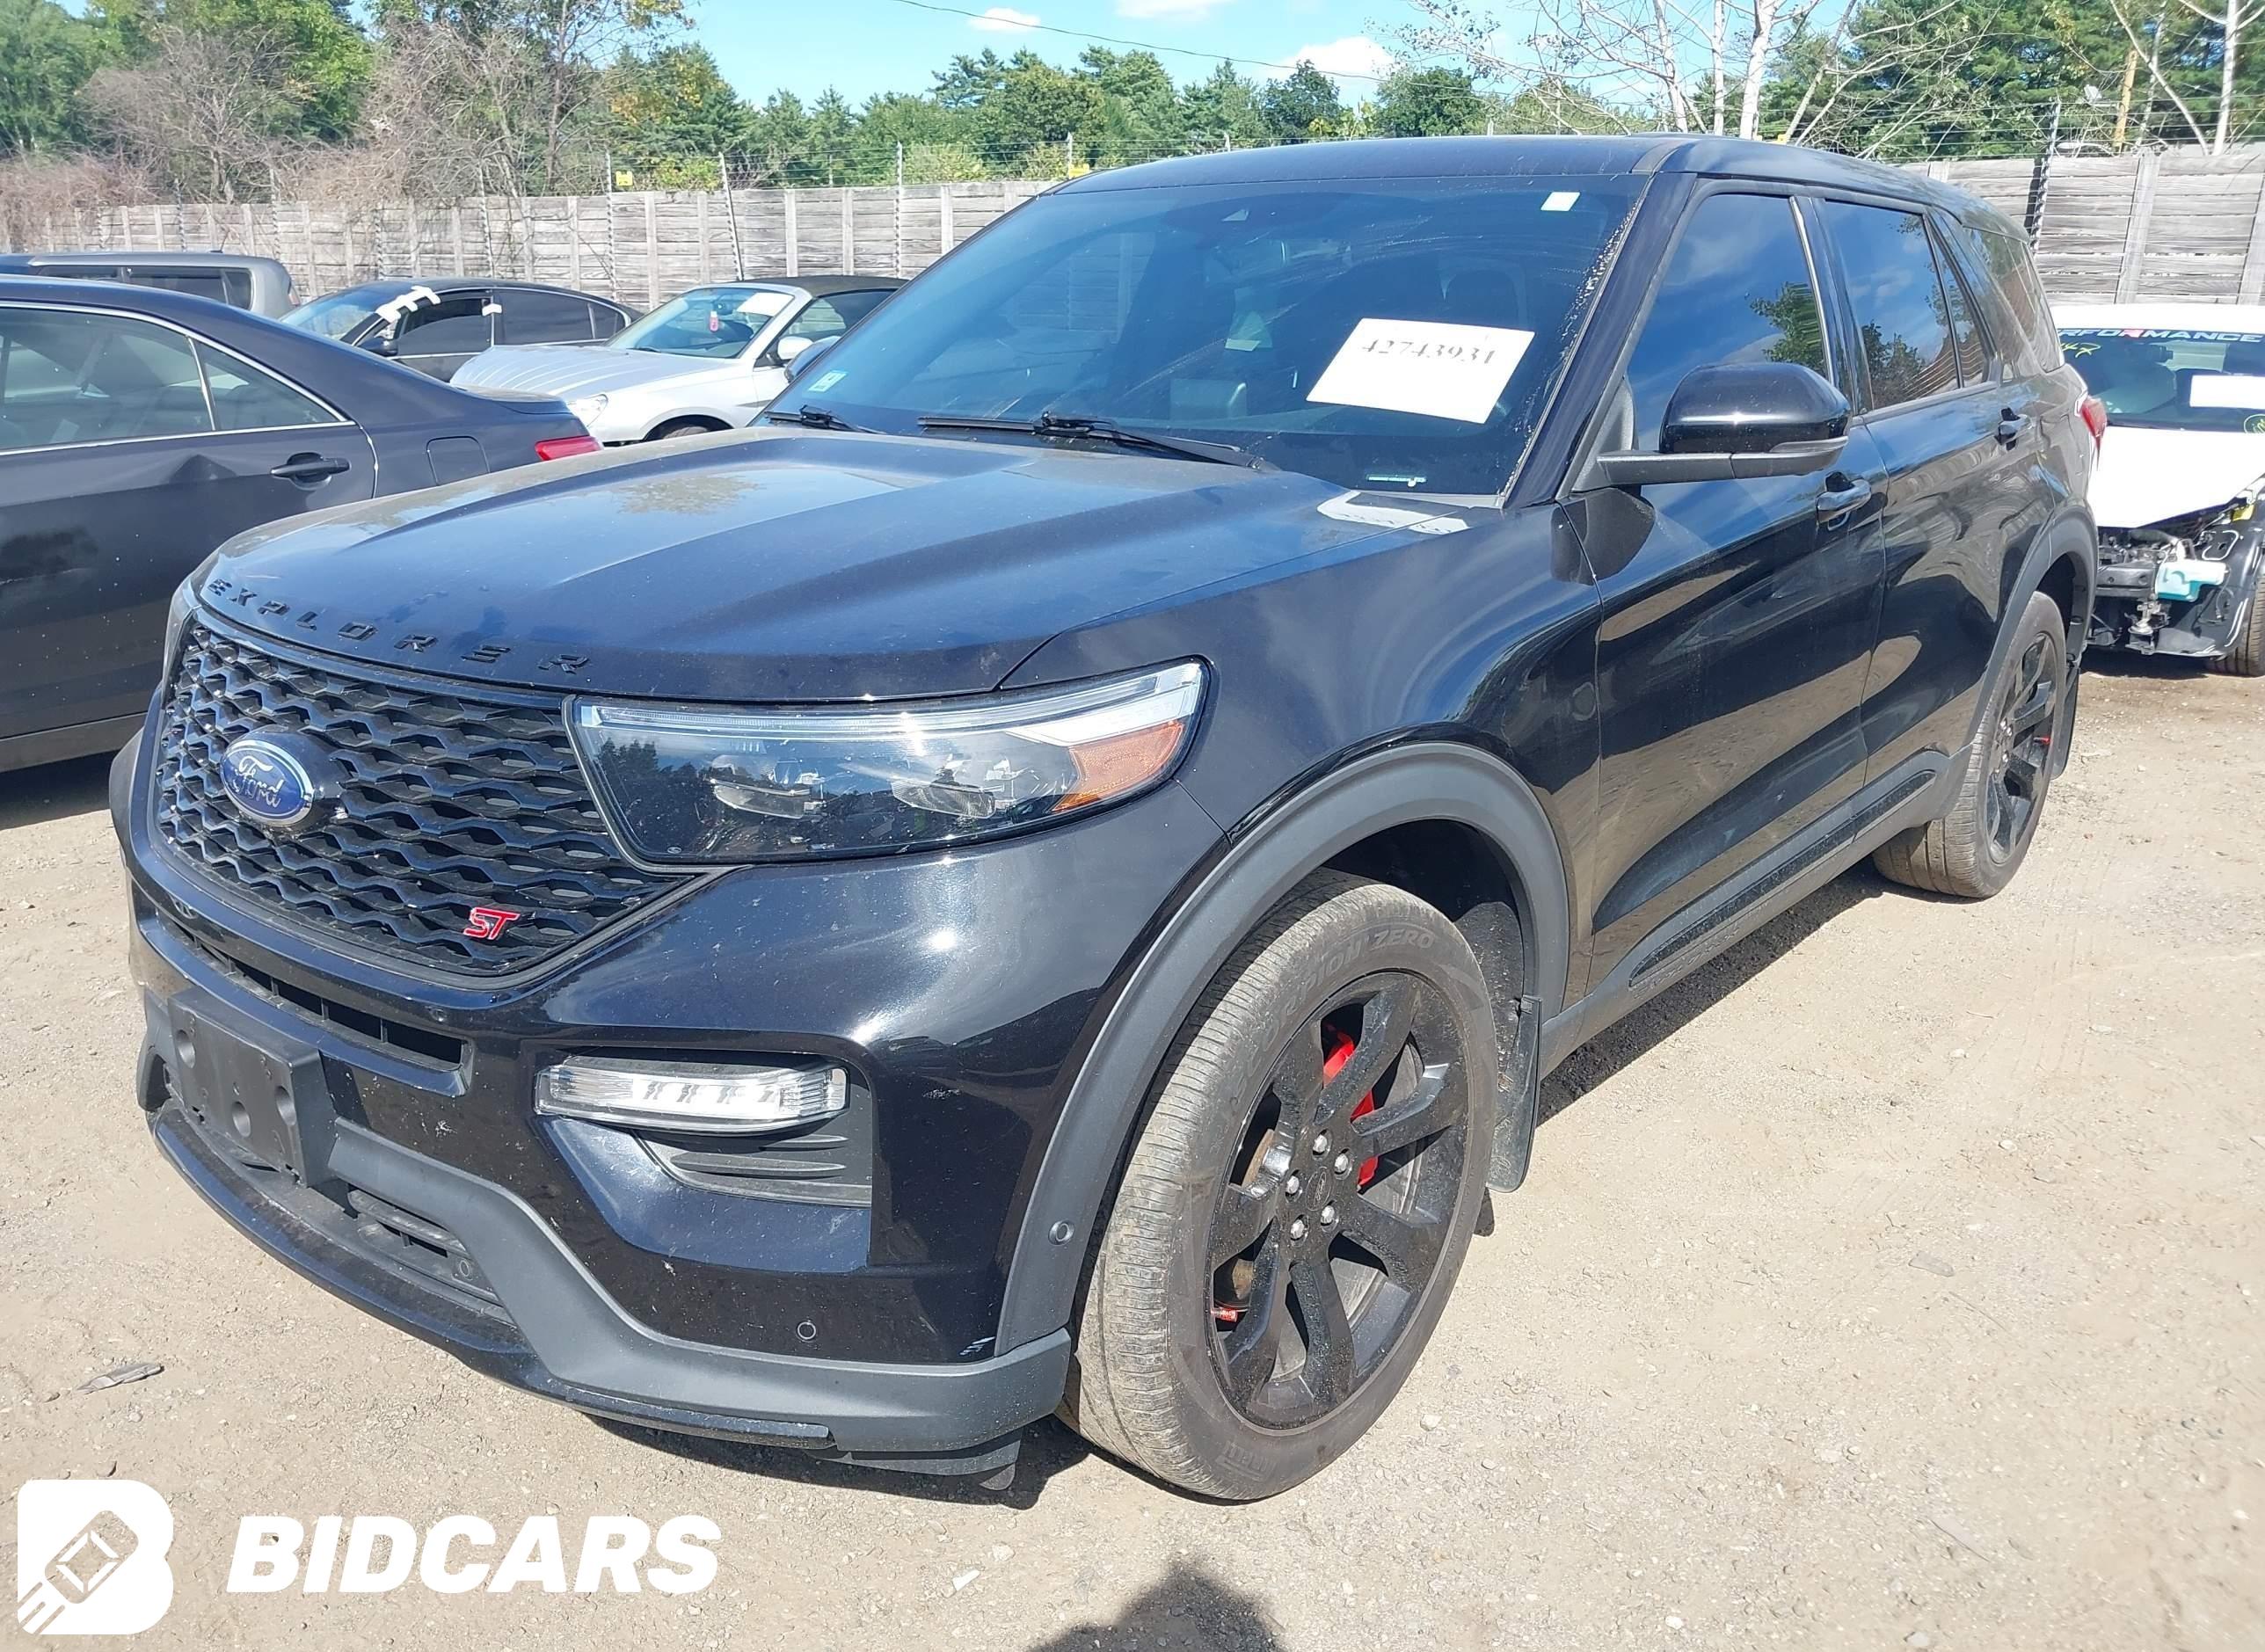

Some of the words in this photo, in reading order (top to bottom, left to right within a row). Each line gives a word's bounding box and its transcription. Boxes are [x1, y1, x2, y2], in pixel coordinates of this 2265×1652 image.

[1361, 338, 1497, 364] 42743931
[208, 578, 592, 675] EXPLORER
[232, 755, 284, 808] Ford
[463, 906, 521, 940] ST
[1371, 928, 1436, 951] ZERO
